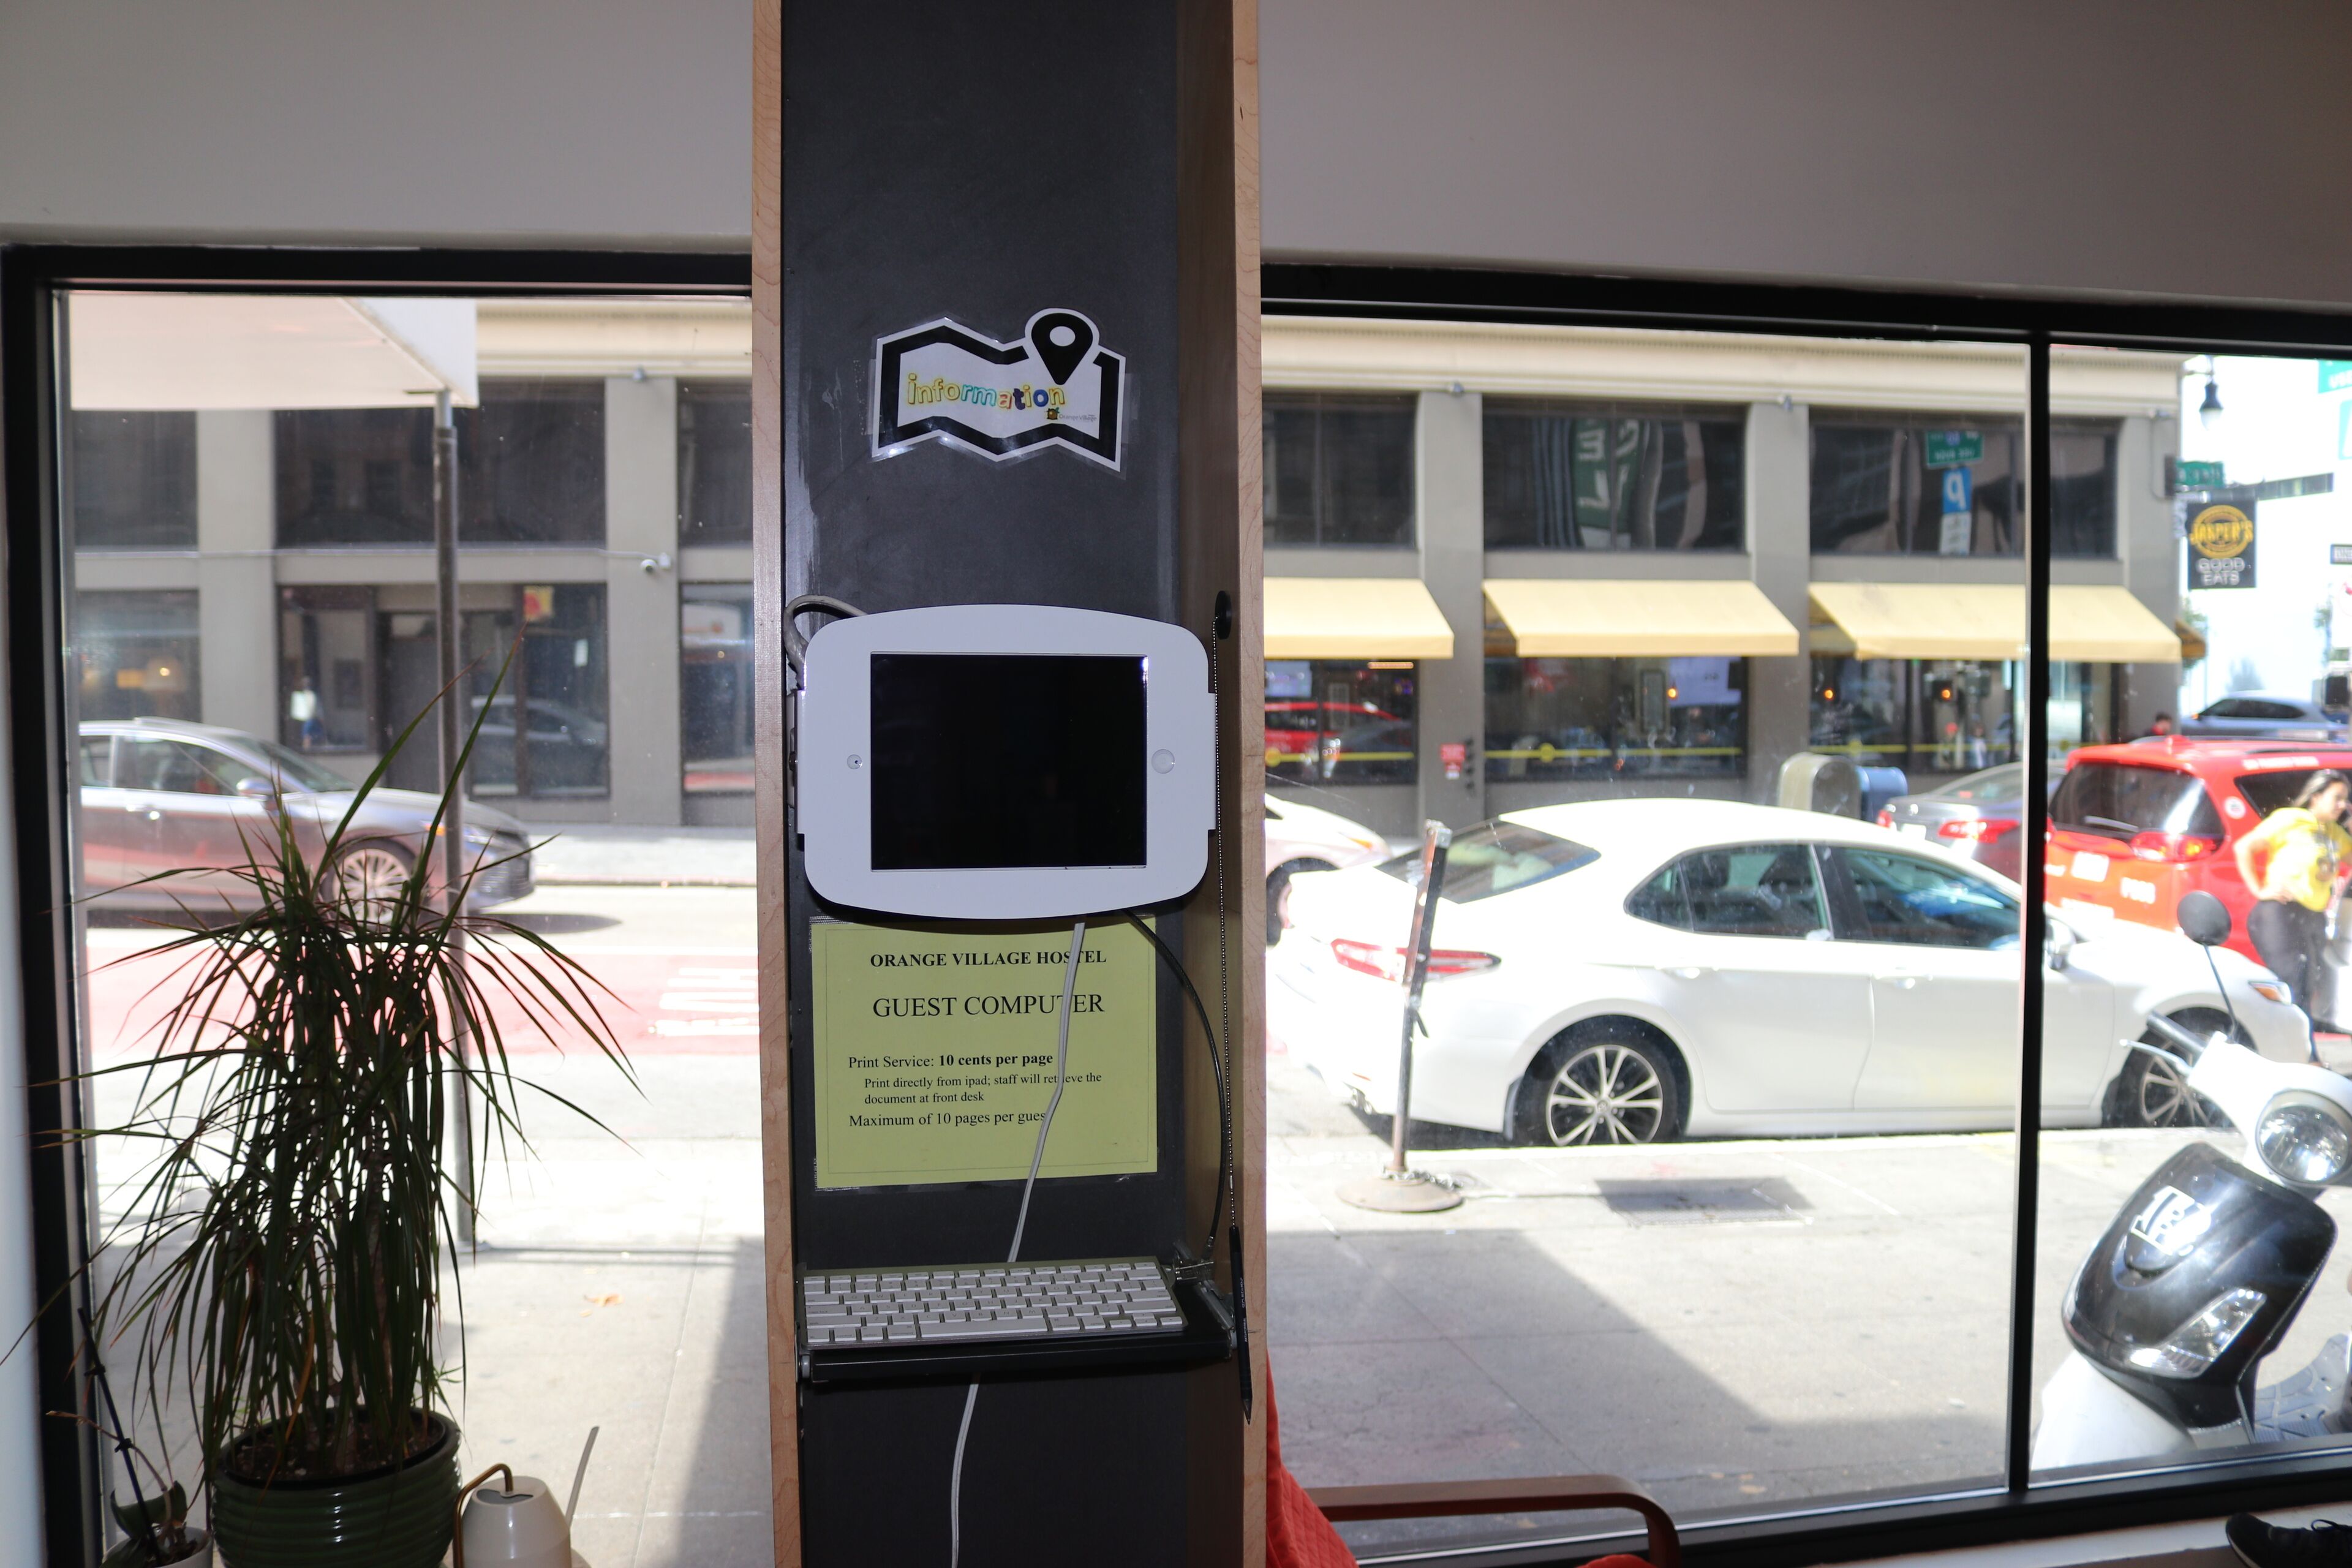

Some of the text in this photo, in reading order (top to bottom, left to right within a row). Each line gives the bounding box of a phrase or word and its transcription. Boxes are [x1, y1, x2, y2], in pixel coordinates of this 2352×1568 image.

[907, 373, 1065, 410] information
[2196, 557, 2245, 573] GOOD
[2201, 571, 2239, 585] EATS
[870, 953, 947, 967] ORANGE
[952, 951, 1031, 966] VILLAGE
[873, 997, 957, 1017] GUEST
[849, 1054, 1054, 1068] Print Service: 10 cents per page
[865, 1072, 1102, 1090] Print directly from ipad; staff will reteve the
[864, 1091, 984, 1104] document at front desk
[850, 1112, 1046, 1127] Maximum of 10 pages per gues
